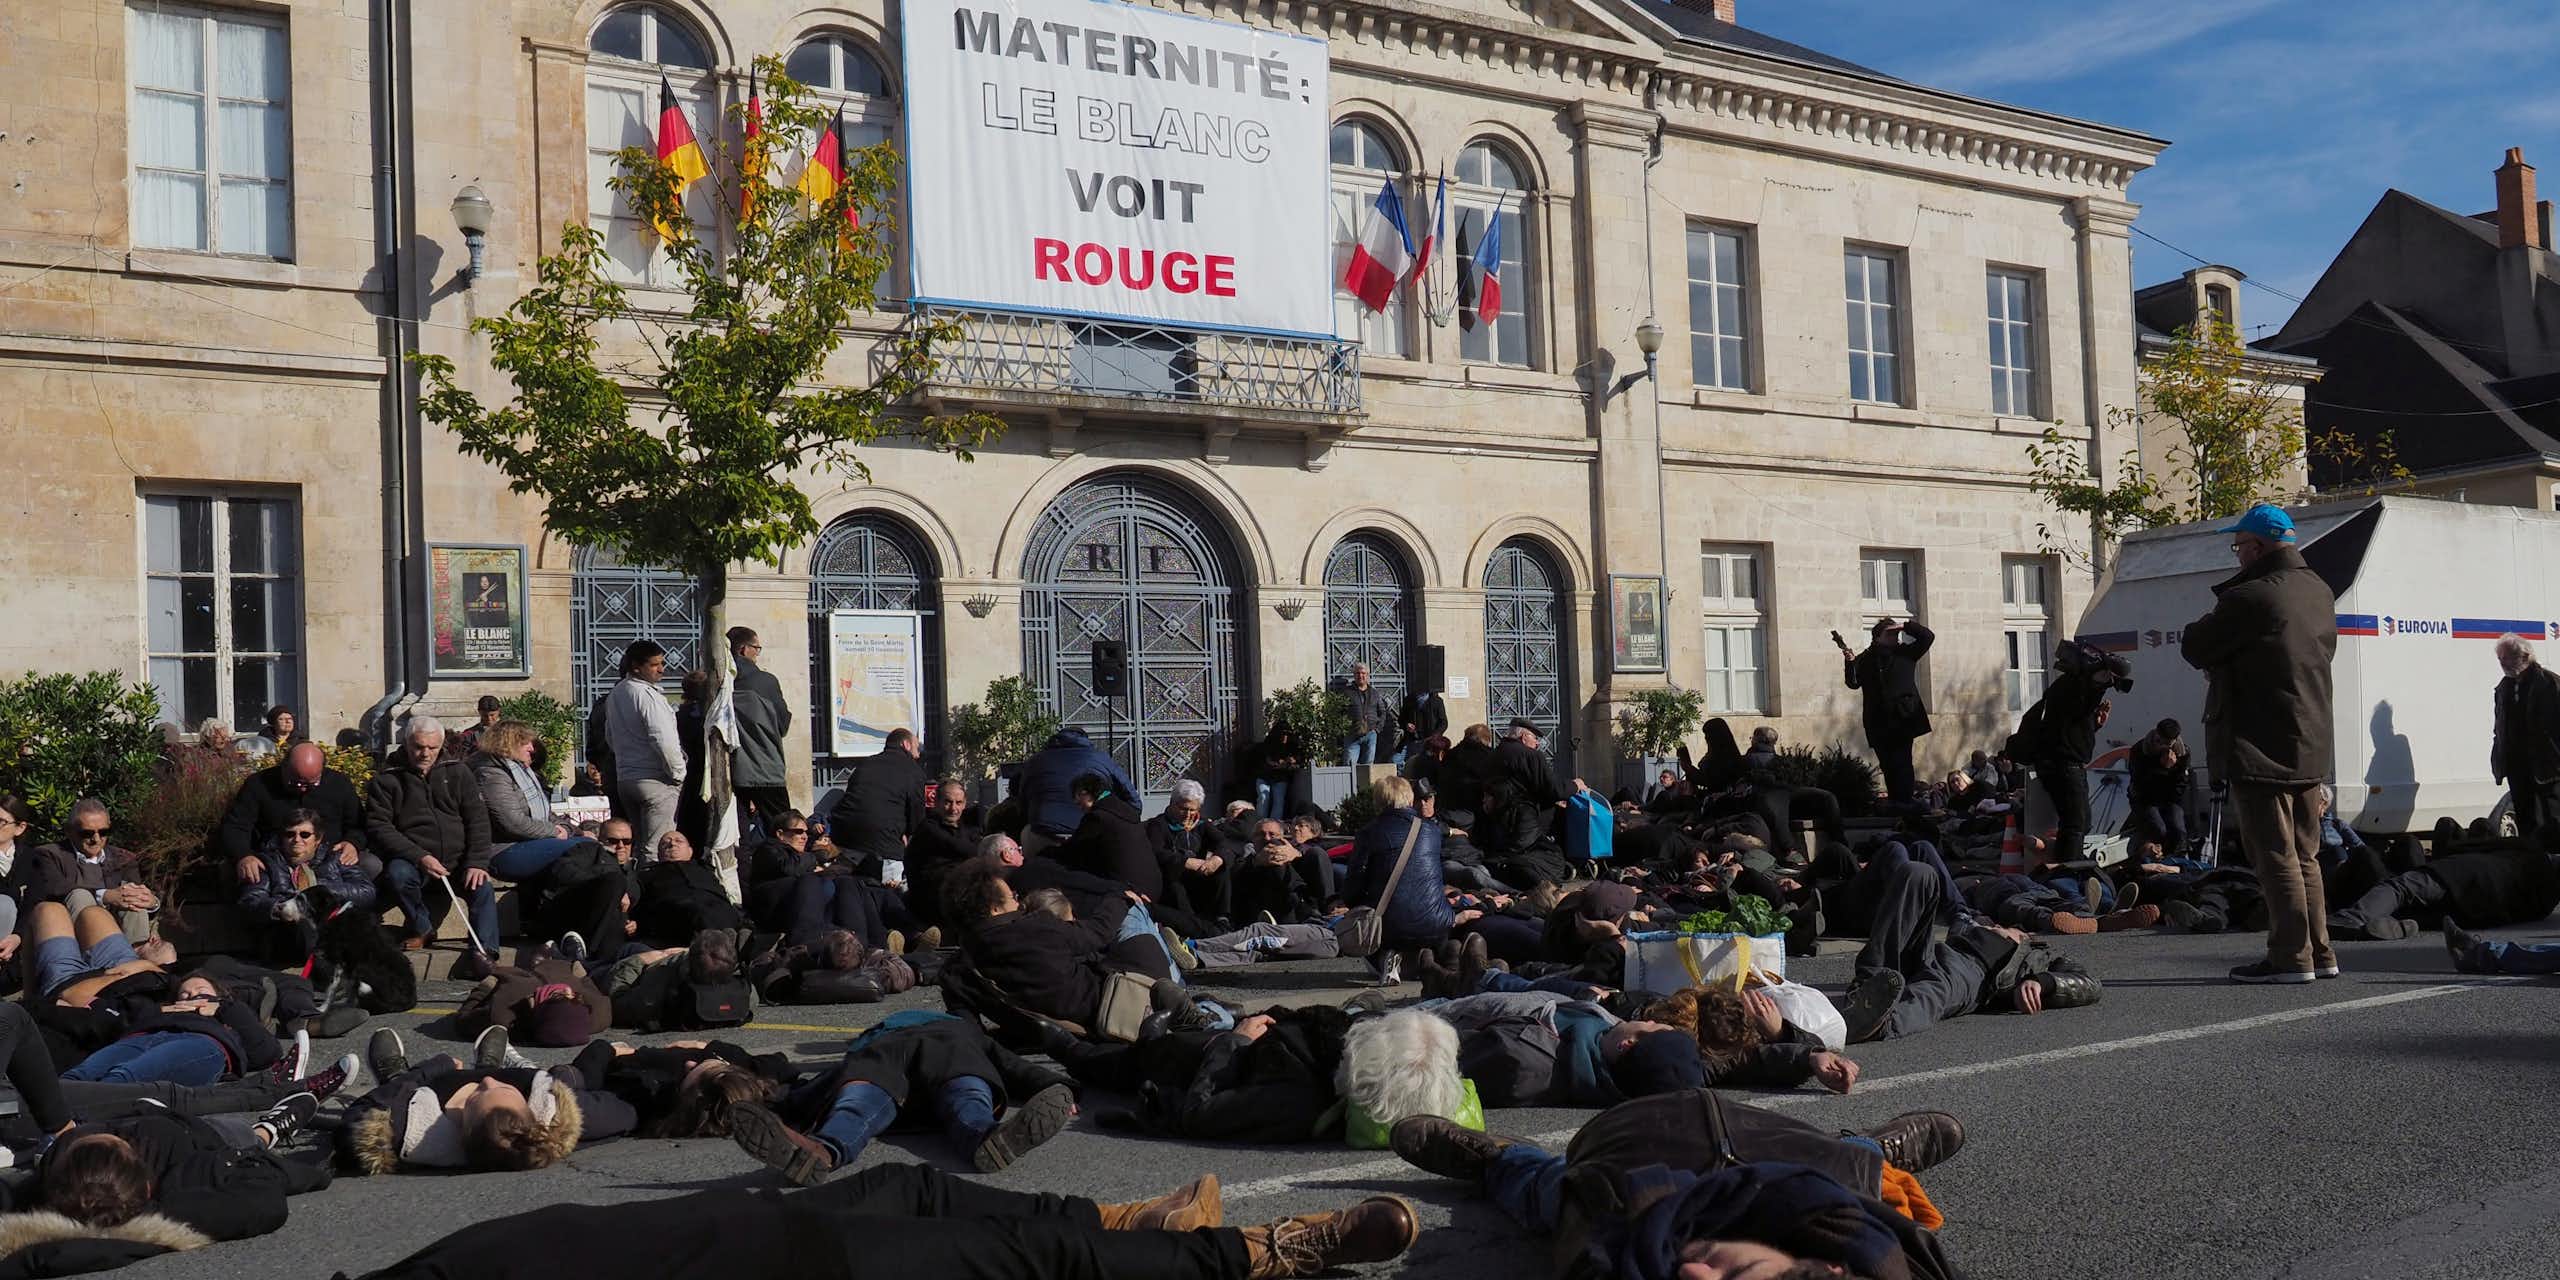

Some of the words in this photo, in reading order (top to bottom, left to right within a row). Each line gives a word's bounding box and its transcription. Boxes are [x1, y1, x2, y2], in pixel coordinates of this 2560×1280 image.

[953, 8, 1309, 104] MATERNITÉ:
[982, 82, 1057, 136] LE
[1077, 95, 1271, 164] BLANC
[1065, 168, 1204, 224] VOIT
[1033, 237, 1236, 298] ROUGE
[466, 629, 477, 639] LE
[478, 628, 510, 640] BLANC
[2398, 620, 2448, 634] EUROVIA
